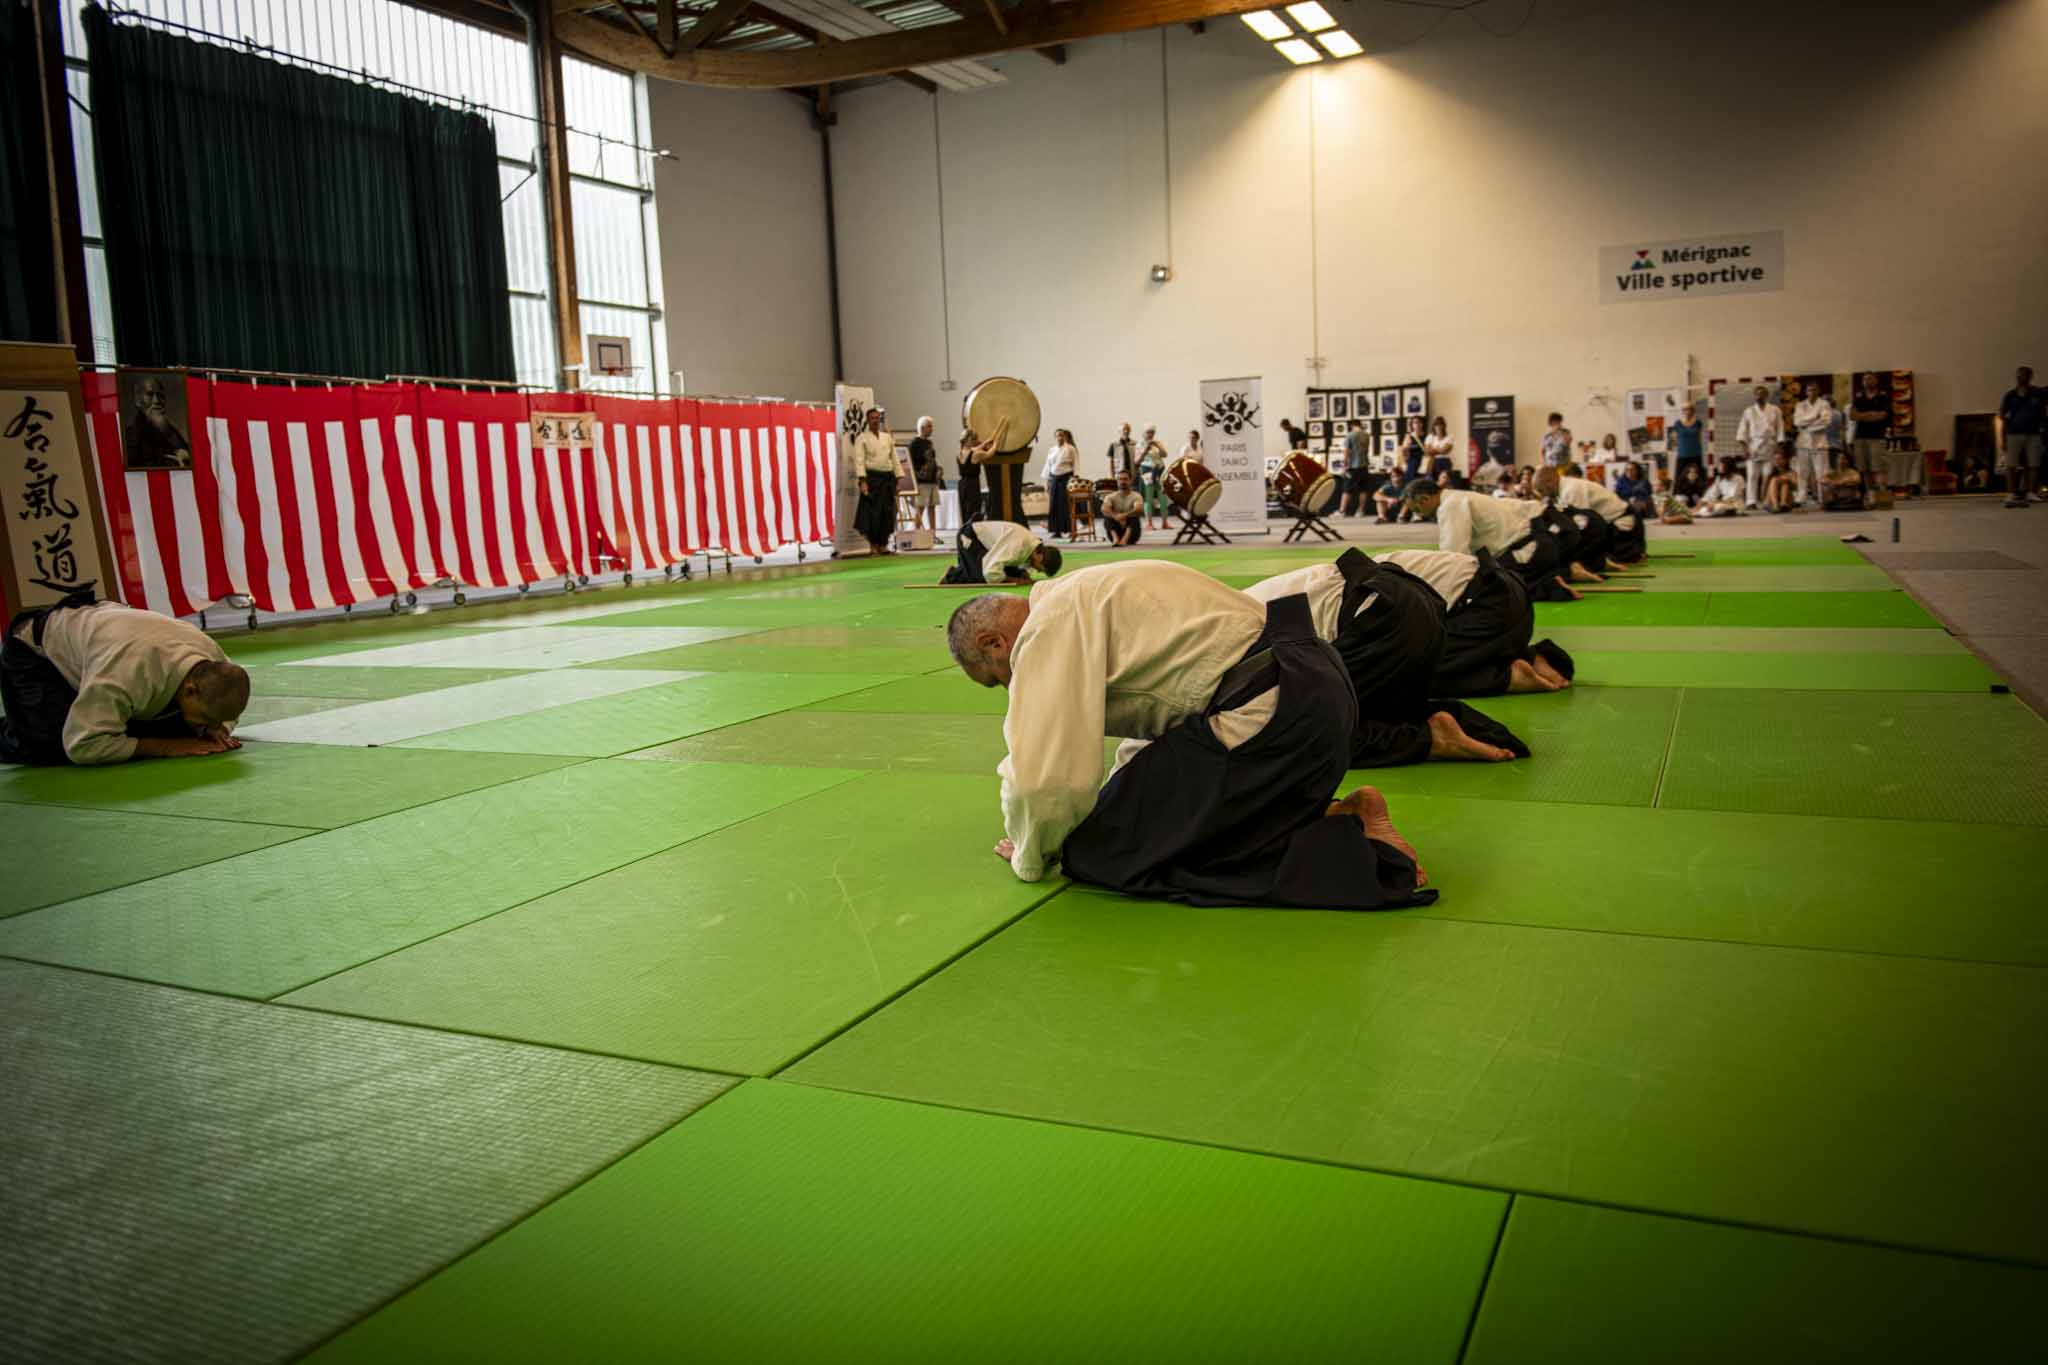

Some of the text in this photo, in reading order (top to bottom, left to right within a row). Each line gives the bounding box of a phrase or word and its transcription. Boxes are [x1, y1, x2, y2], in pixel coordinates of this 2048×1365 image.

[1662, 245, 1751, 264] Mérignac
[1616, 265, 1764, 291] Ville sportive
[1215, 471, 1259, 481] NSEMBLE
